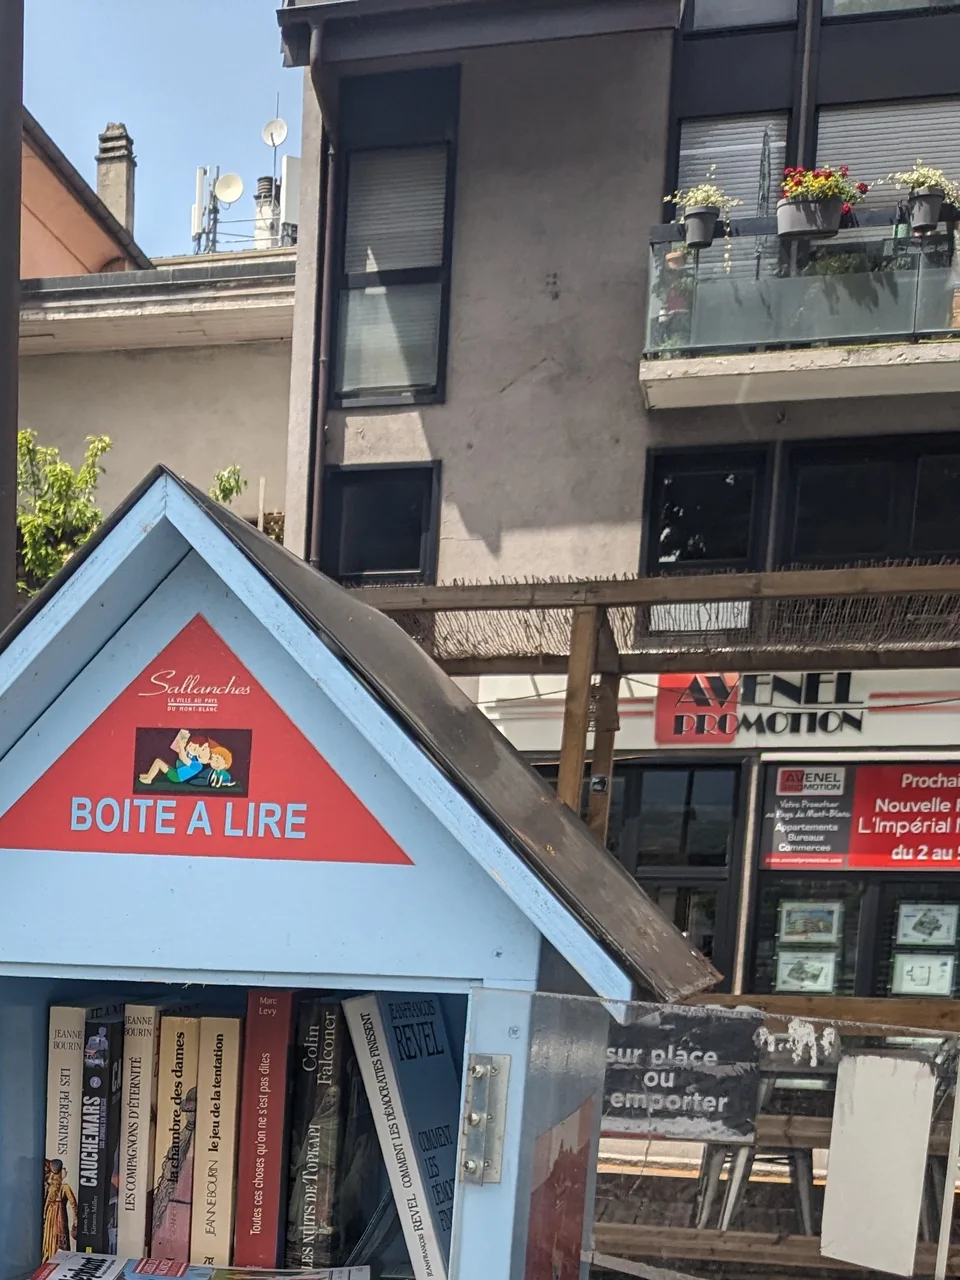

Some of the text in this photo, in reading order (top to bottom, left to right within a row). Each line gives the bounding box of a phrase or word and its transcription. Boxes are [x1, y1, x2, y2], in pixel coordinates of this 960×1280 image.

[138, 669, 251, 696] Sallanches
[675, 672, 864, 708] AVENEL
[673, 710, 864, 736] PROMOTION
[785, 772, 842, 783] AVENEL
[874, 797, 952, 813] Nouvelle
[70, 796, 307, 839] BOITE A LIRE
[774, 822, 838, 833] Appartements
[858, 815, 951, 838] L'Impérial
[778, 843, 831, 852] Commerces
[787, 833, 825, 842] Bureaux
[891, 844, 913, 860] du
[916, 845, 928, 860] 2
[931, 847, 953, 861] au
[258, 1007, 277, 1017] Levy
[259, 996, 278, 1005] Marc
[124, 1027, 152, 1037] BOURIN
[125, 1015, 153, 1025] JEANNE
[53, 1041, 82, 1051] BOURIN
[54, 1029, 83, 1040] JEANNE
[360, 1012, 380, 1058] FINISSENT
[393, 1021, 445, 1061] REVEL
[171, 1031, 185, 1079] dames
[302, 1025, 320, 1072] Colin
[316, 1012, 337, 1085] Falconer
[606, 1044, 718, 1066] sur place
[372, 1059, 397, 1122] DÉMOCRATIES
[643, 1070, 675, 1088] ou
[170, 1081, 183, 1106] des
[207, 1033, 224, 1152] le jeu de la tentation
[609, 1092, 729, 1113] emporter
[58, 1067, 72, 1155] LES PÉRÉGRINES
[80, 1095, 101, 1187] CAUCHEMARS
[125, 1056, 142, 1212] LES COMPAGNONS D'ÉTERNITÉ
[168, 1109, 182, 1168] chambre
[388, 1123, 401, 1140] LES
[250, 1052, 272, 1236] Toutes ces choses qu'on ne s'est pas dites
[393, 1142, 413, 1189] COMMENT
[424, 1156, 440, 1180] LES
[305, 1184, 318, 1202] DE
[302, 1205, 316, 1244] NUITS
[406, 1193, 424, 1233] REVEL
[301, 1246, 314, 1270] LES
